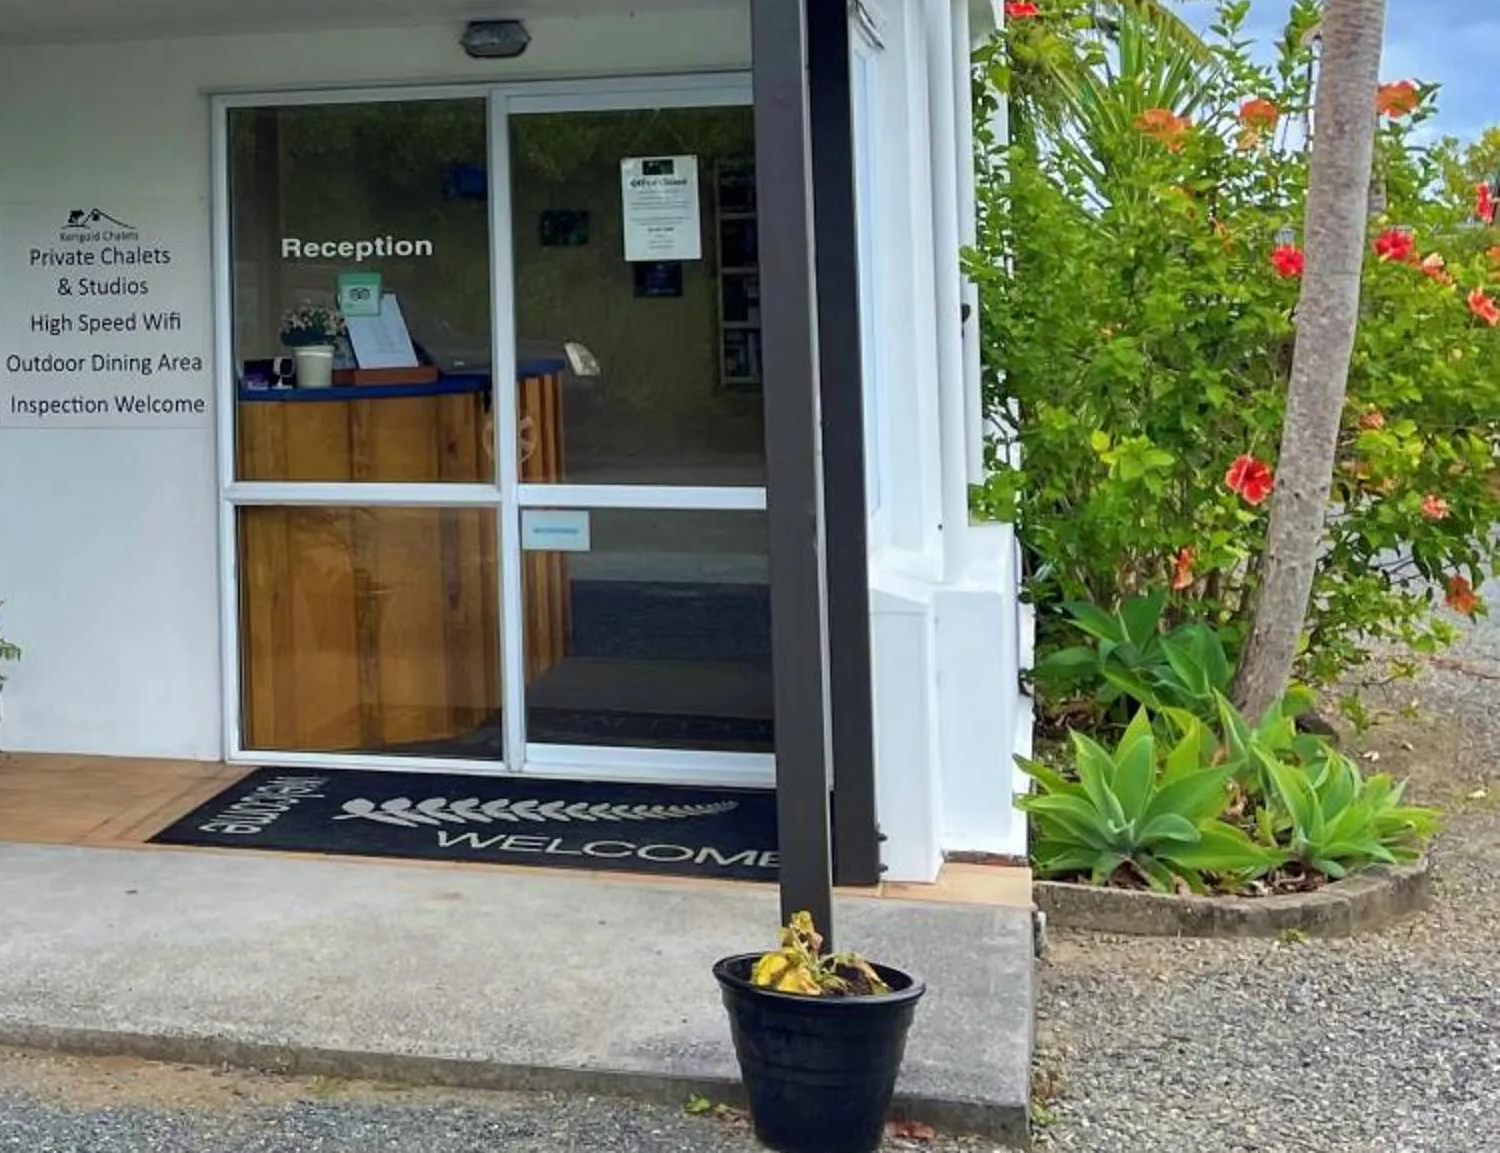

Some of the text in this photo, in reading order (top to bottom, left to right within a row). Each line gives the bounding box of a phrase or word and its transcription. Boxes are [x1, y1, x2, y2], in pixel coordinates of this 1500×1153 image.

[29, 247, 171, 266] Private Chalets
[281, 236, 434, 262] Reception
[57, 277, 149, 296] & Studios
[31, 312, 182, 335] High Speed Wifi
[6, 354, 203, 375] Outdoor Dining Area
[10, 395, 206, 417] Inspection Welcome
